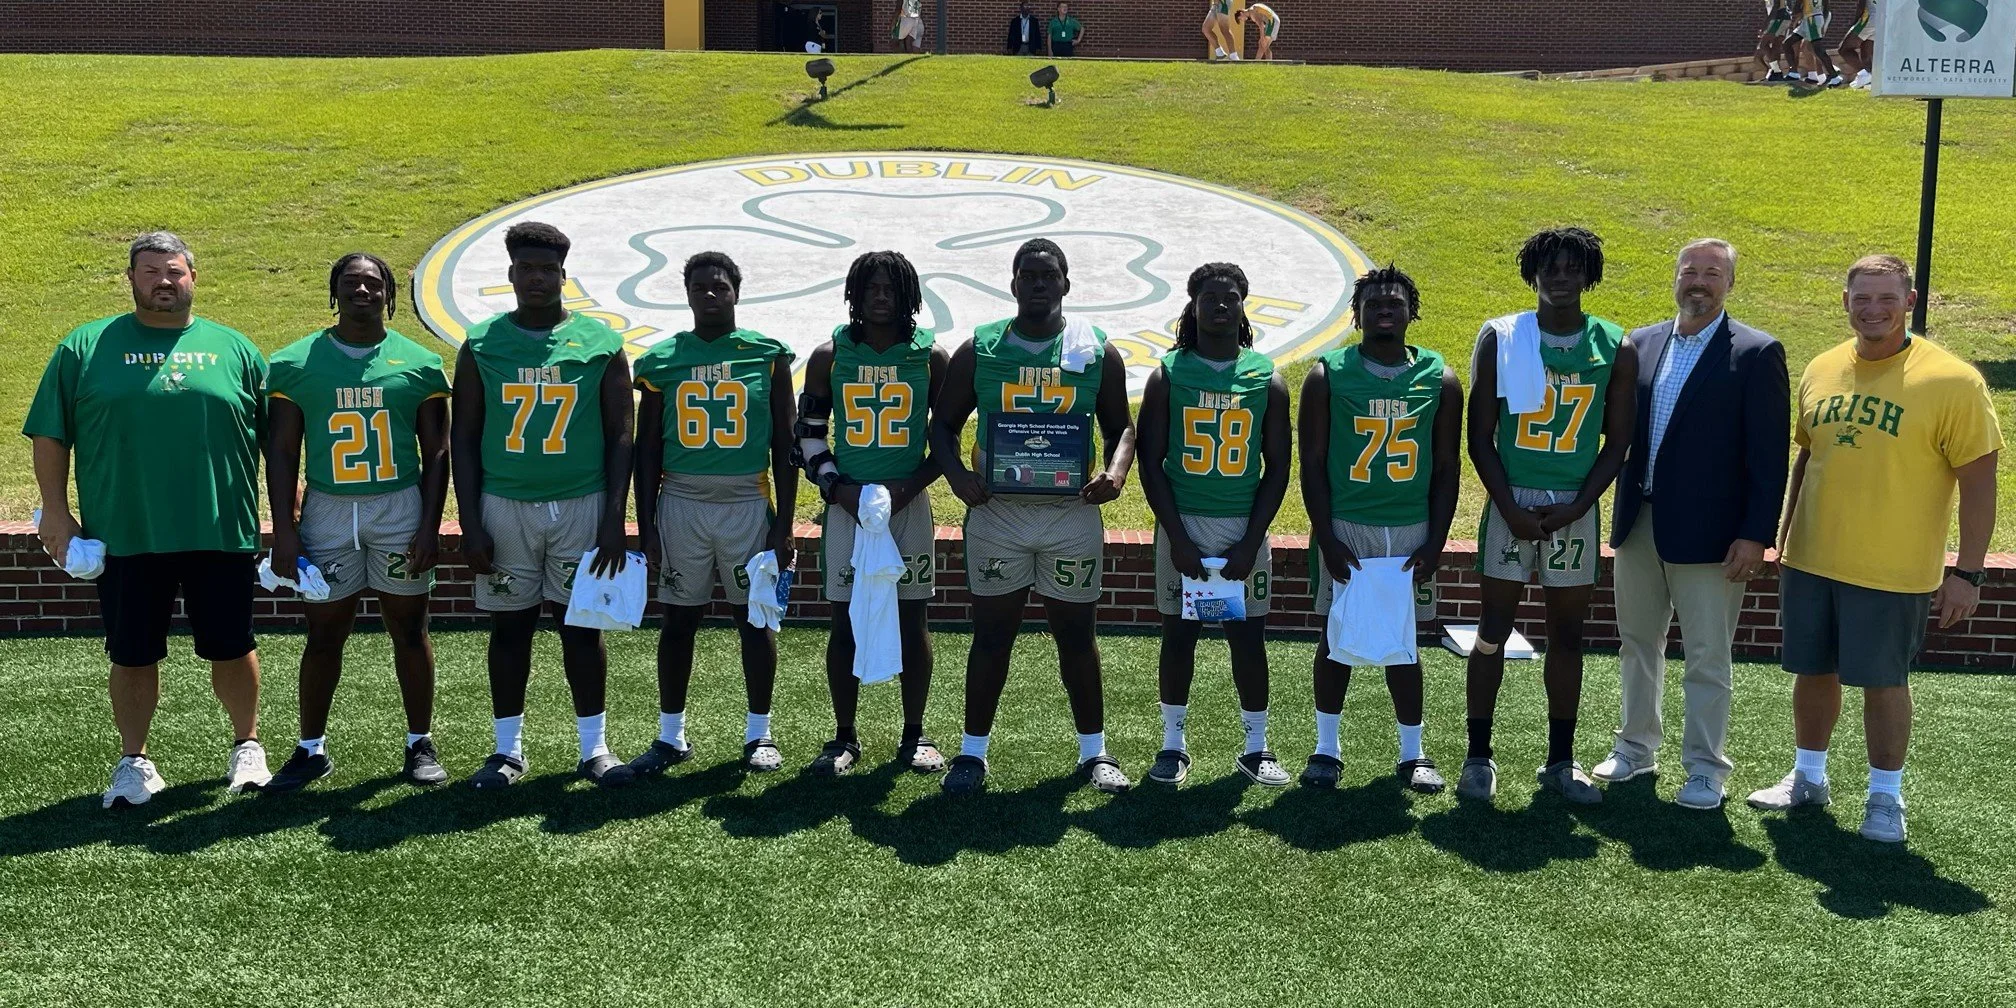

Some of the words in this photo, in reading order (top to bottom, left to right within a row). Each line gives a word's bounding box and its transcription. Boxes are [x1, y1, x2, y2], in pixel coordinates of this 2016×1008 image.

[1900, 58, 1995, 74] ALTERRA
[735, 160, 1107, 191] DUBLIN
[124, 352, 166, 365] DUB
[172, 351, 219, 365] CITY
[691, 363, 732, 381] IRISH
[518, 366, 562, 383] IRISH
[858, 365, 898, 384] IRISH
[1018, 367, 1061, 387] IRISH
[1546, 367, 1581, 385] RISH
[336, 387, 384, 408] IRISH
[1198, 390, 1241, 410] IRISH
[1368, 399, 1409, 418] IRISH
[502, 383, 578, 454] 77
[676, 380, 748, 448] 63
[843, 382, 913, 447] 52
[1515, 383, 1597, 453] 27
[1811, 394, 1904, 437] IRISH
[328, 410, 398, 484] 21
[1182, 406, 1254, 476] 58
[1350, 415, 1420, 483] 75
[1547, 537, 1586, 571] 27
[561, 561, 580, 591] 7
[732, 563, 750, 590] 6
[1054, 557, 1097, 589] 57
[1244, 570, 1268, 601] 8
[1415, 580, 1434, 606] 5
